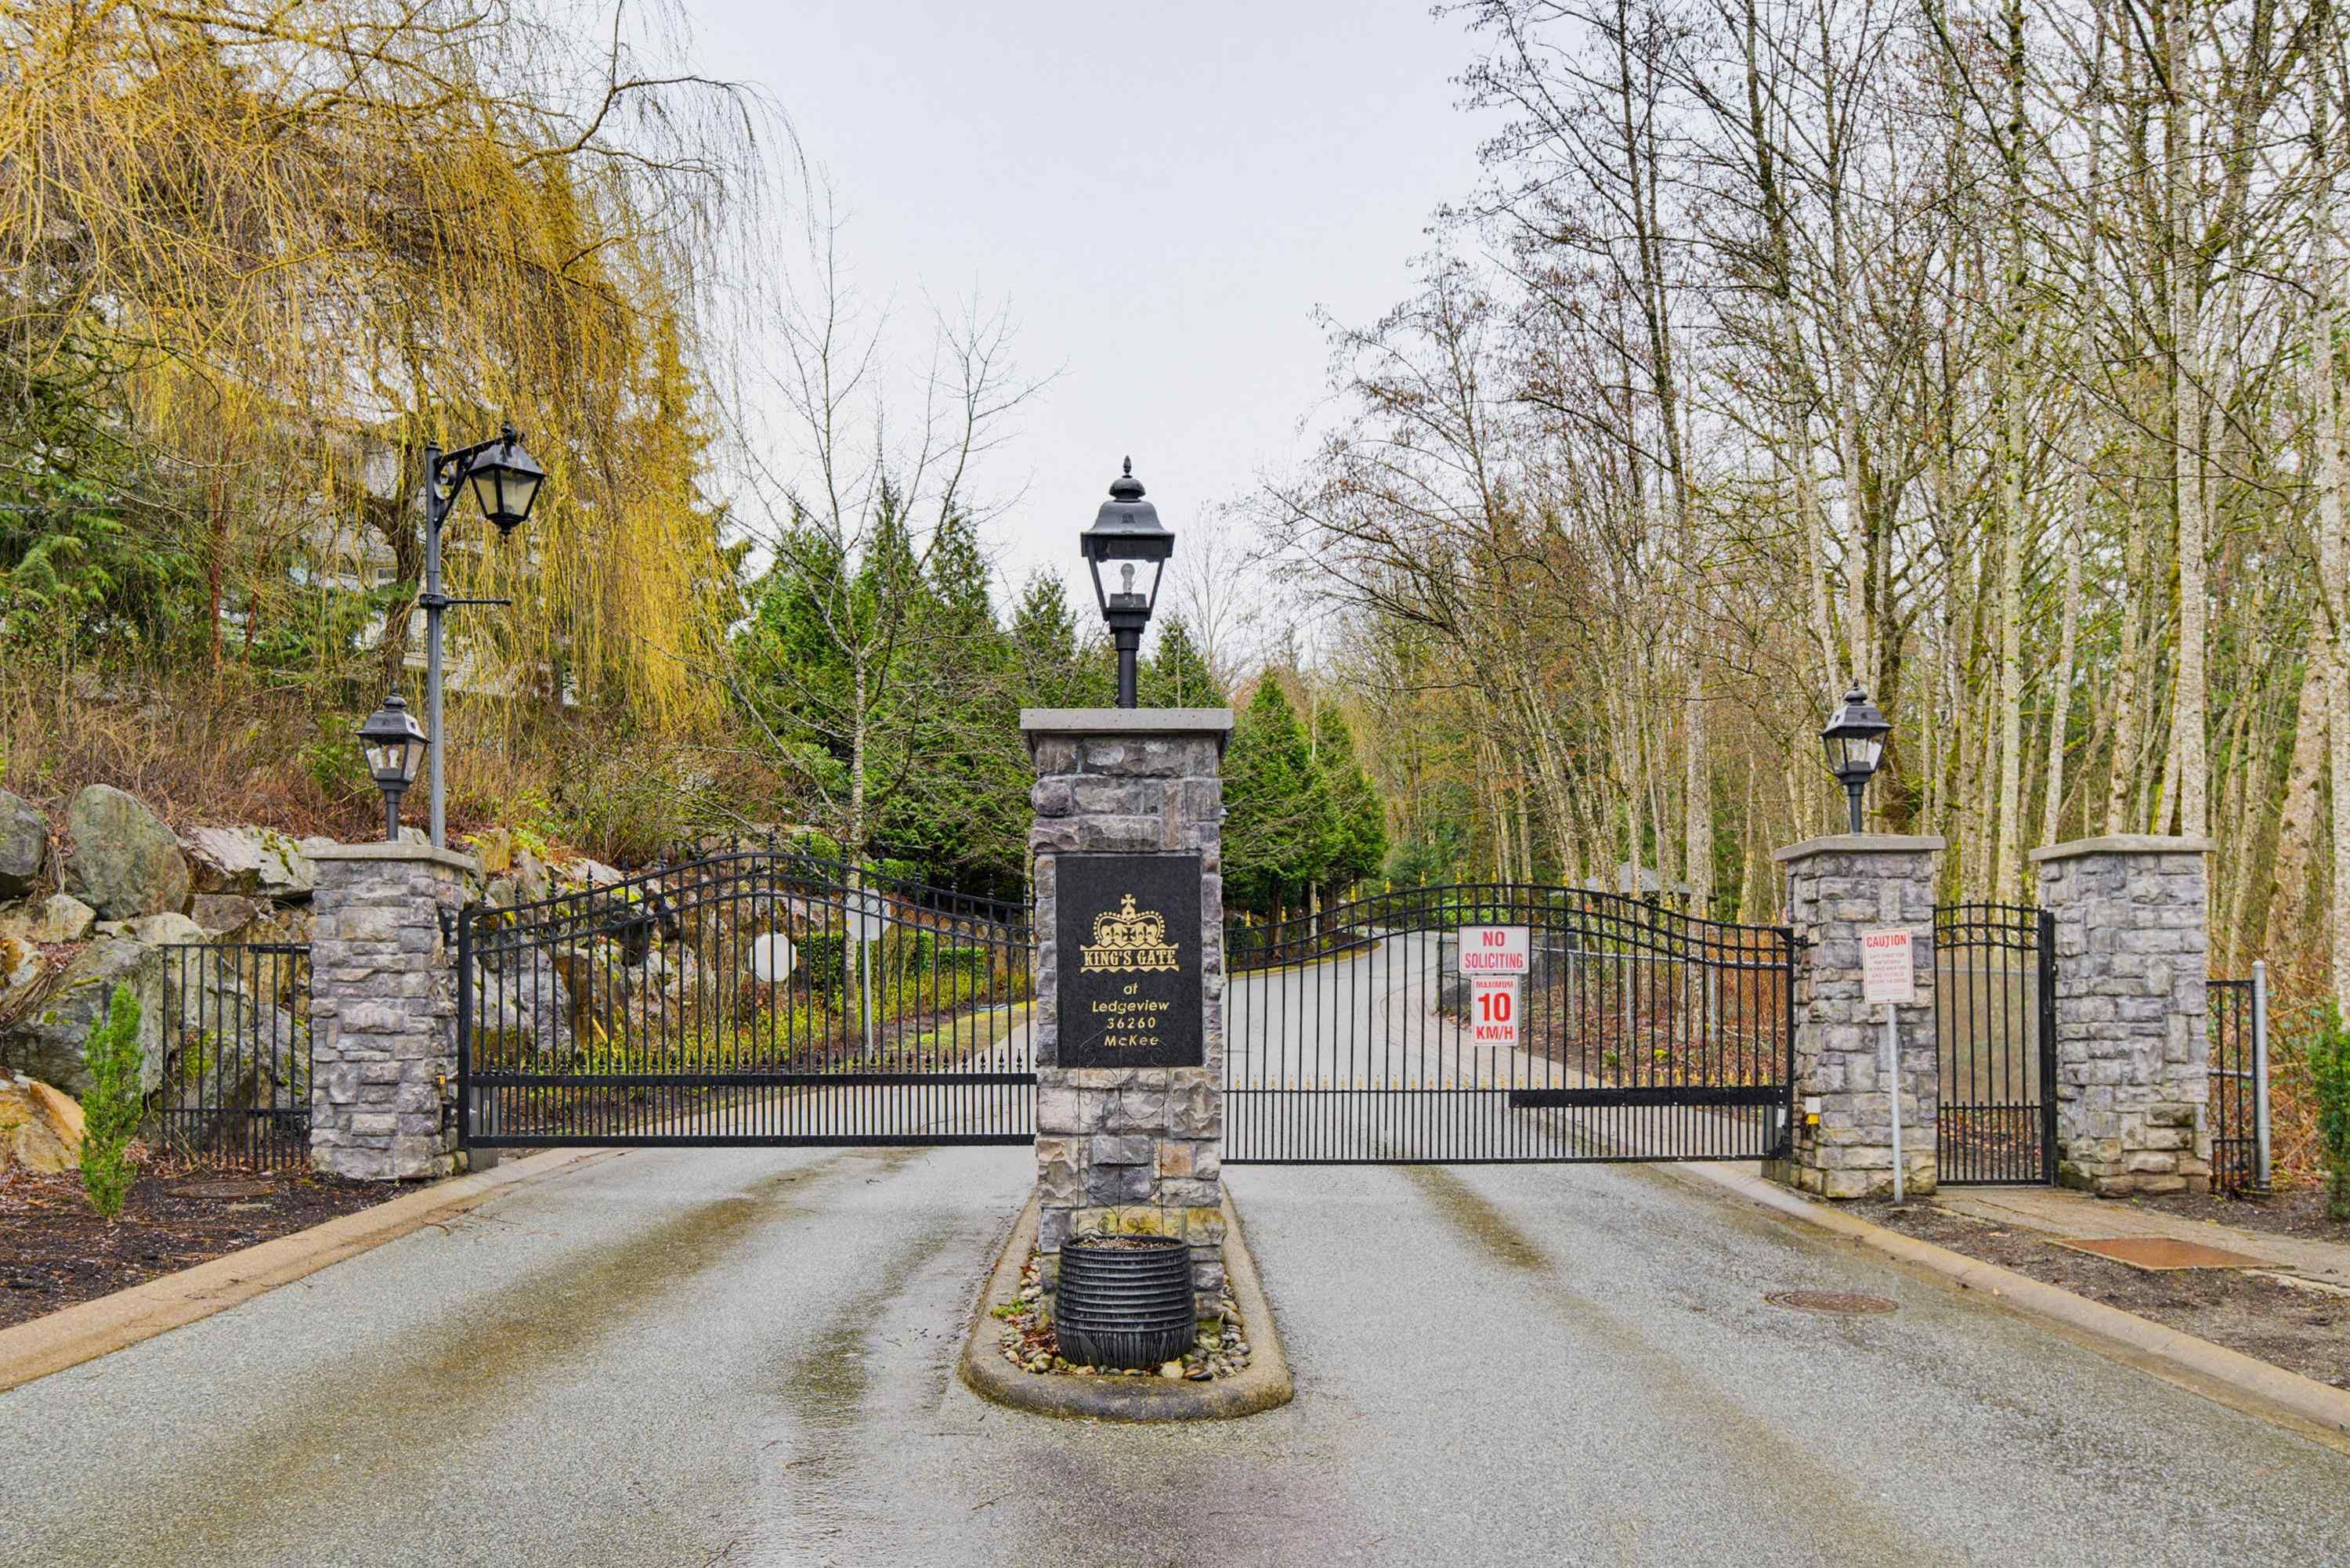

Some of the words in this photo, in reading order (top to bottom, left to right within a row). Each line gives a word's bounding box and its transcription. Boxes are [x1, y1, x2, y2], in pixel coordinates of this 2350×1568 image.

[1483, 931, 1505, 947] NO
[1867, 934, 1907, 948] CAUTION
[1084, 950, 1132, 966] KING'S
[1137, 950, 1176, 966] GATE
[1466, 953, 1523, 969] SOLICITING
[1092, 1000, 1170, 1014] Ledgeview
[1478, 992, 1511, 1022] 10
[1106, 1017, 1156, 1029] 36260
[1104, 1035, 1159, 1046] McKee
[1477, 1027, 1513, 1040] KM/H
